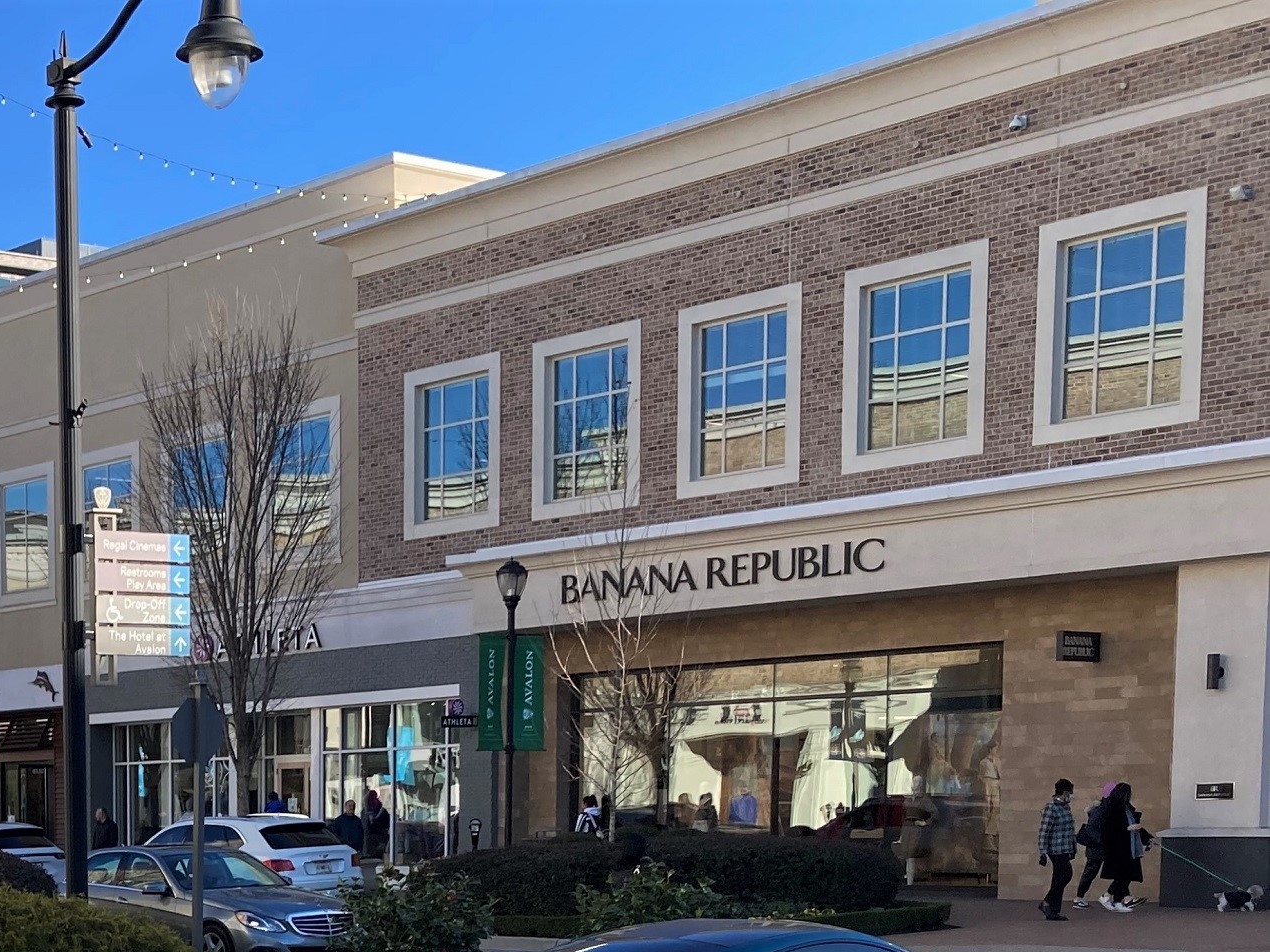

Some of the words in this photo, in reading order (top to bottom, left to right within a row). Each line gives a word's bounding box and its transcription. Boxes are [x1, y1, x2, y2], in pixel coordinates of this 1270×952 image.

[103, 539, 128, 552] Regal
[130, 540, 167, 552] Cinemas
[120, 566, 167, 578] Restrooms
[560, 560, 698, 605] BANANA
[706, 538, 886, 589] REPUBLIC
[126, 579, 145, 591] Play
[146, 579, 167, 591] Area
[124, 598, 166, 611] Drop-Off
[142, 612, 166, 623] Zone
[109, 630, 127, 641] The
[129, 630, 154, 642] Hotel
[156, 632, 166, 642] at
[217, 623, 323, 659] ALETA
[1064, 635, 1093, 646] BANANA
[135, 644, 166, 655] Avalon
[1062, 647, 1095, 657] REPUBLIC
[487, 649, 496, 706] AVALON
[524, 650, 534, 706] AVALON
[442, 718, 472, 727] ATHLETA
